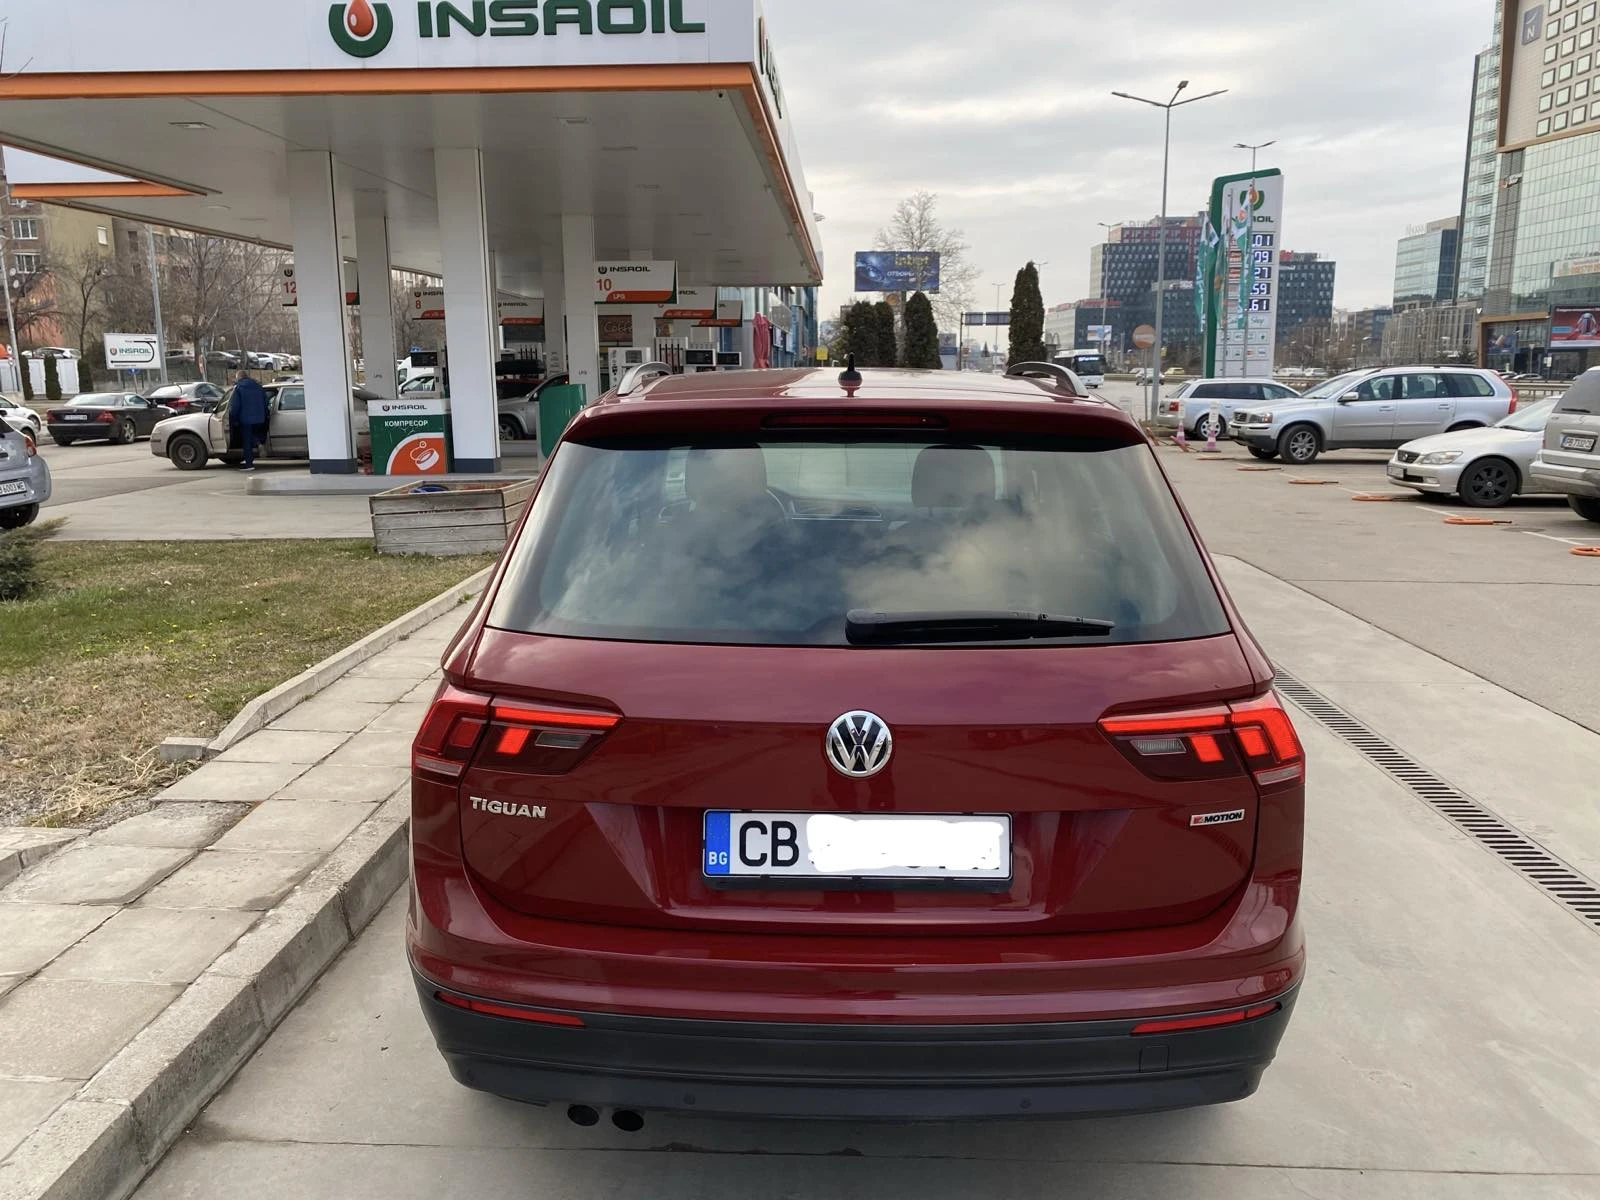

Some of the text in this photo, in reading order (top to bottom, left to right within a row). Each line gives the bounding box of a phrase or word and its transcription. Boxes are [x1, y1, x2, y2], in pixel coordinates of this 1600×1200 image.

[418, 0, 706, 38] INSAOIL
[283, 281, 297, 294] 12
[596, 278, 612, 291] 10
[415, 300, 421, 309] 8
[470, 796, 547, 818] TIGUAN
[739, 820, 800, 867] CB
[708, 852, 728, 865] BG
